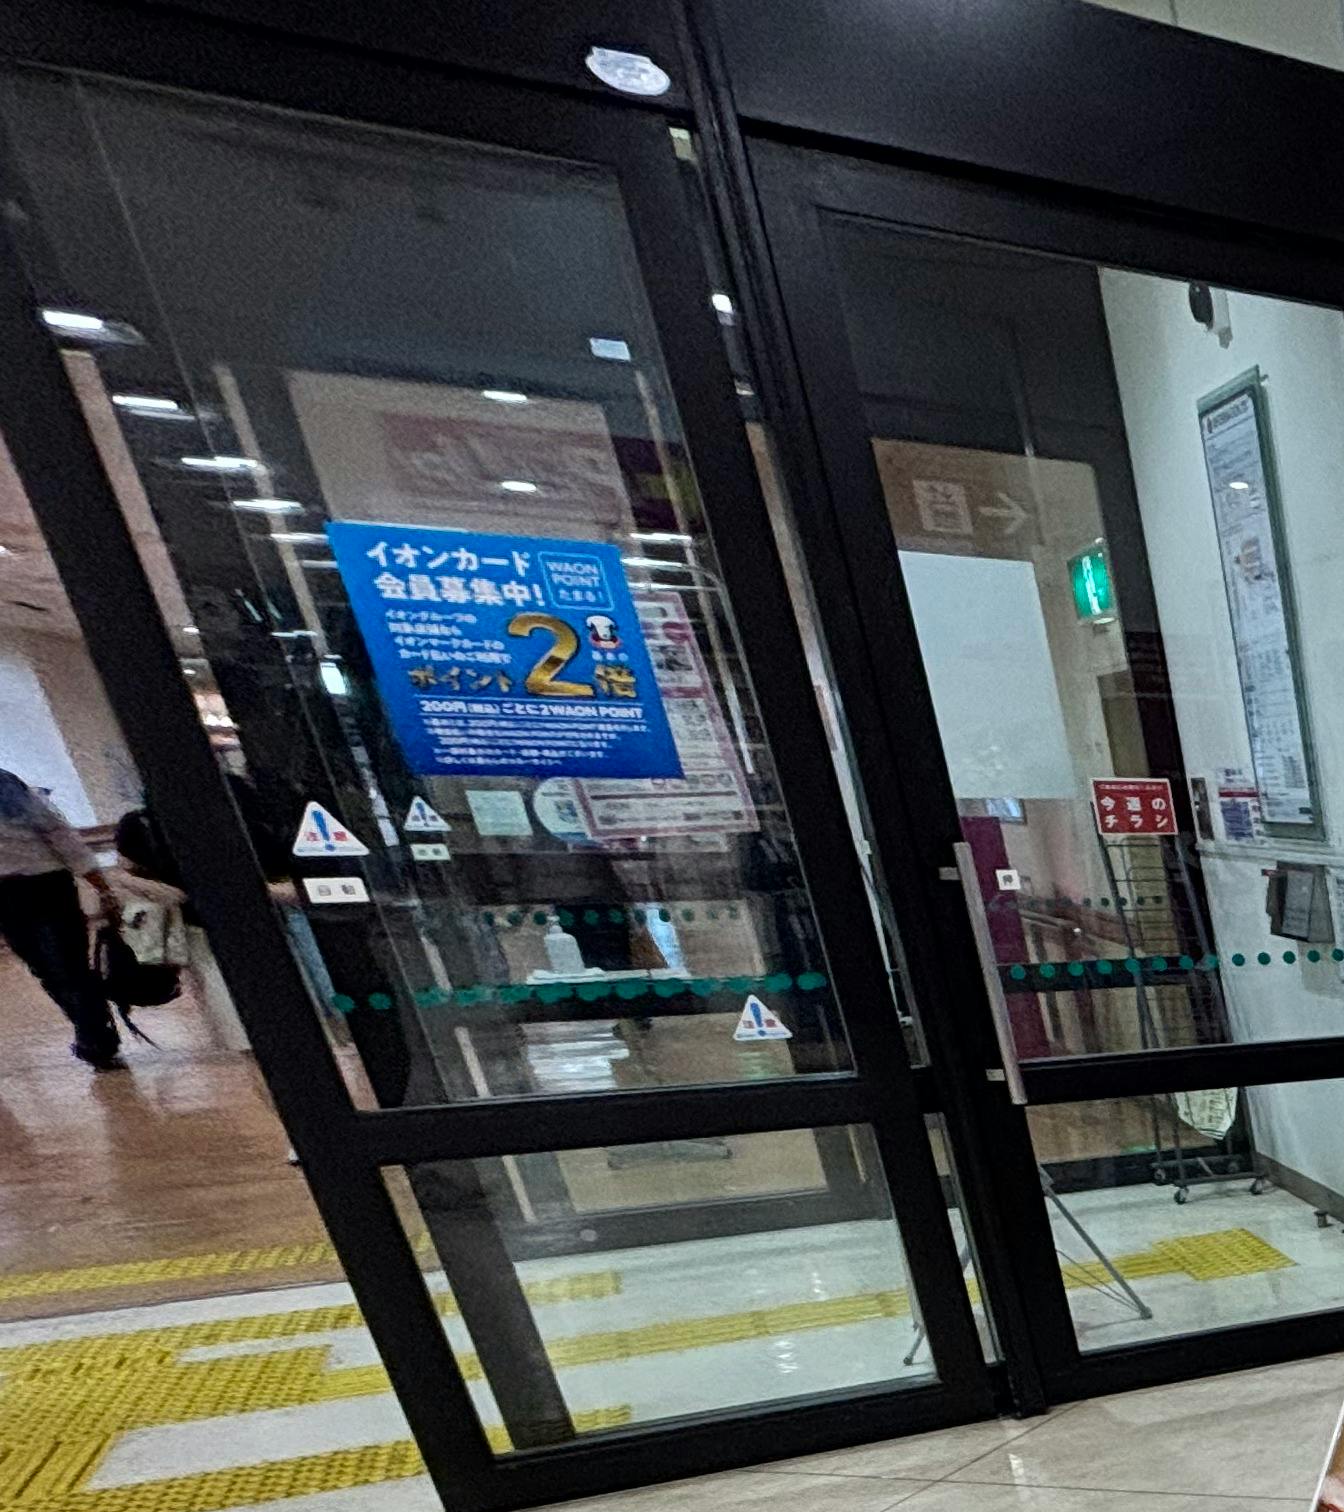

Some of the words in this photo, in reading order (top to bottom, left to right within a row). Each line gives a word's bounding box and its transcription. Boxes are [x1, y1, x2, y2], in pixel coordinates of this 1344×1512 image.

[366, 541, 531, 576] イオンカード
[547, 561, 599, 576] WAON
[373, 571, 546, 608] 会員募集中!
[550, 573, 601, 588] POINT
[507, 611, 595, 698] 2
[408, 664, 513, 693] ポイント
[1100, 796, 1167, 811] 今週の
[1104, 814, 1169, 828] チラシ
